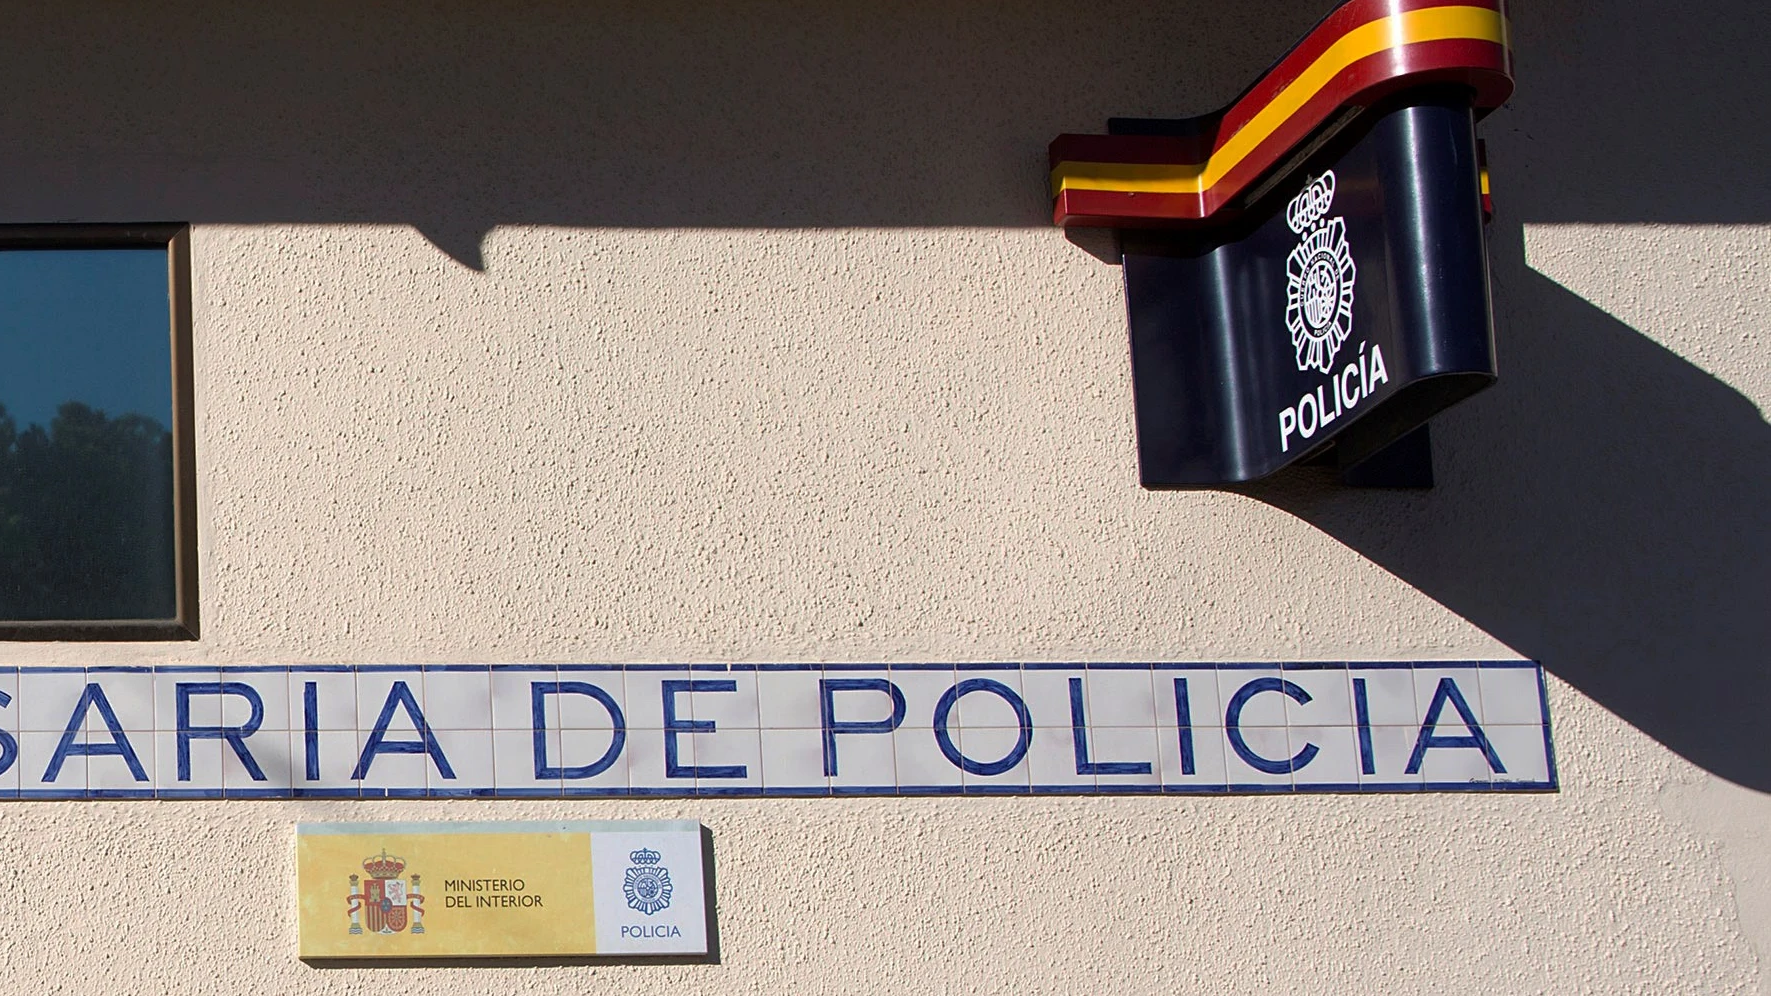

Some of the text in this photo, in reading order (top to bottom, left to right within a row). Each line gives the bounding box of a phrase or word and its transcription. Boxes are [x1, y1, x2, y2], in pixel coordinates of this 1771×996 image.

[1310, 252, 1336, 268] NACIONAL
[1278, 340, 1389, 453] POLICÍA
[531, 679, 748, 780] DE
[820, 676, 1507, 777] POLICIA
[444, 879, 525, 892] MINISTERIO
[445, 894, 543, 908] DEL INTERIOR
[621, 924, 681, 938] POLICIA
